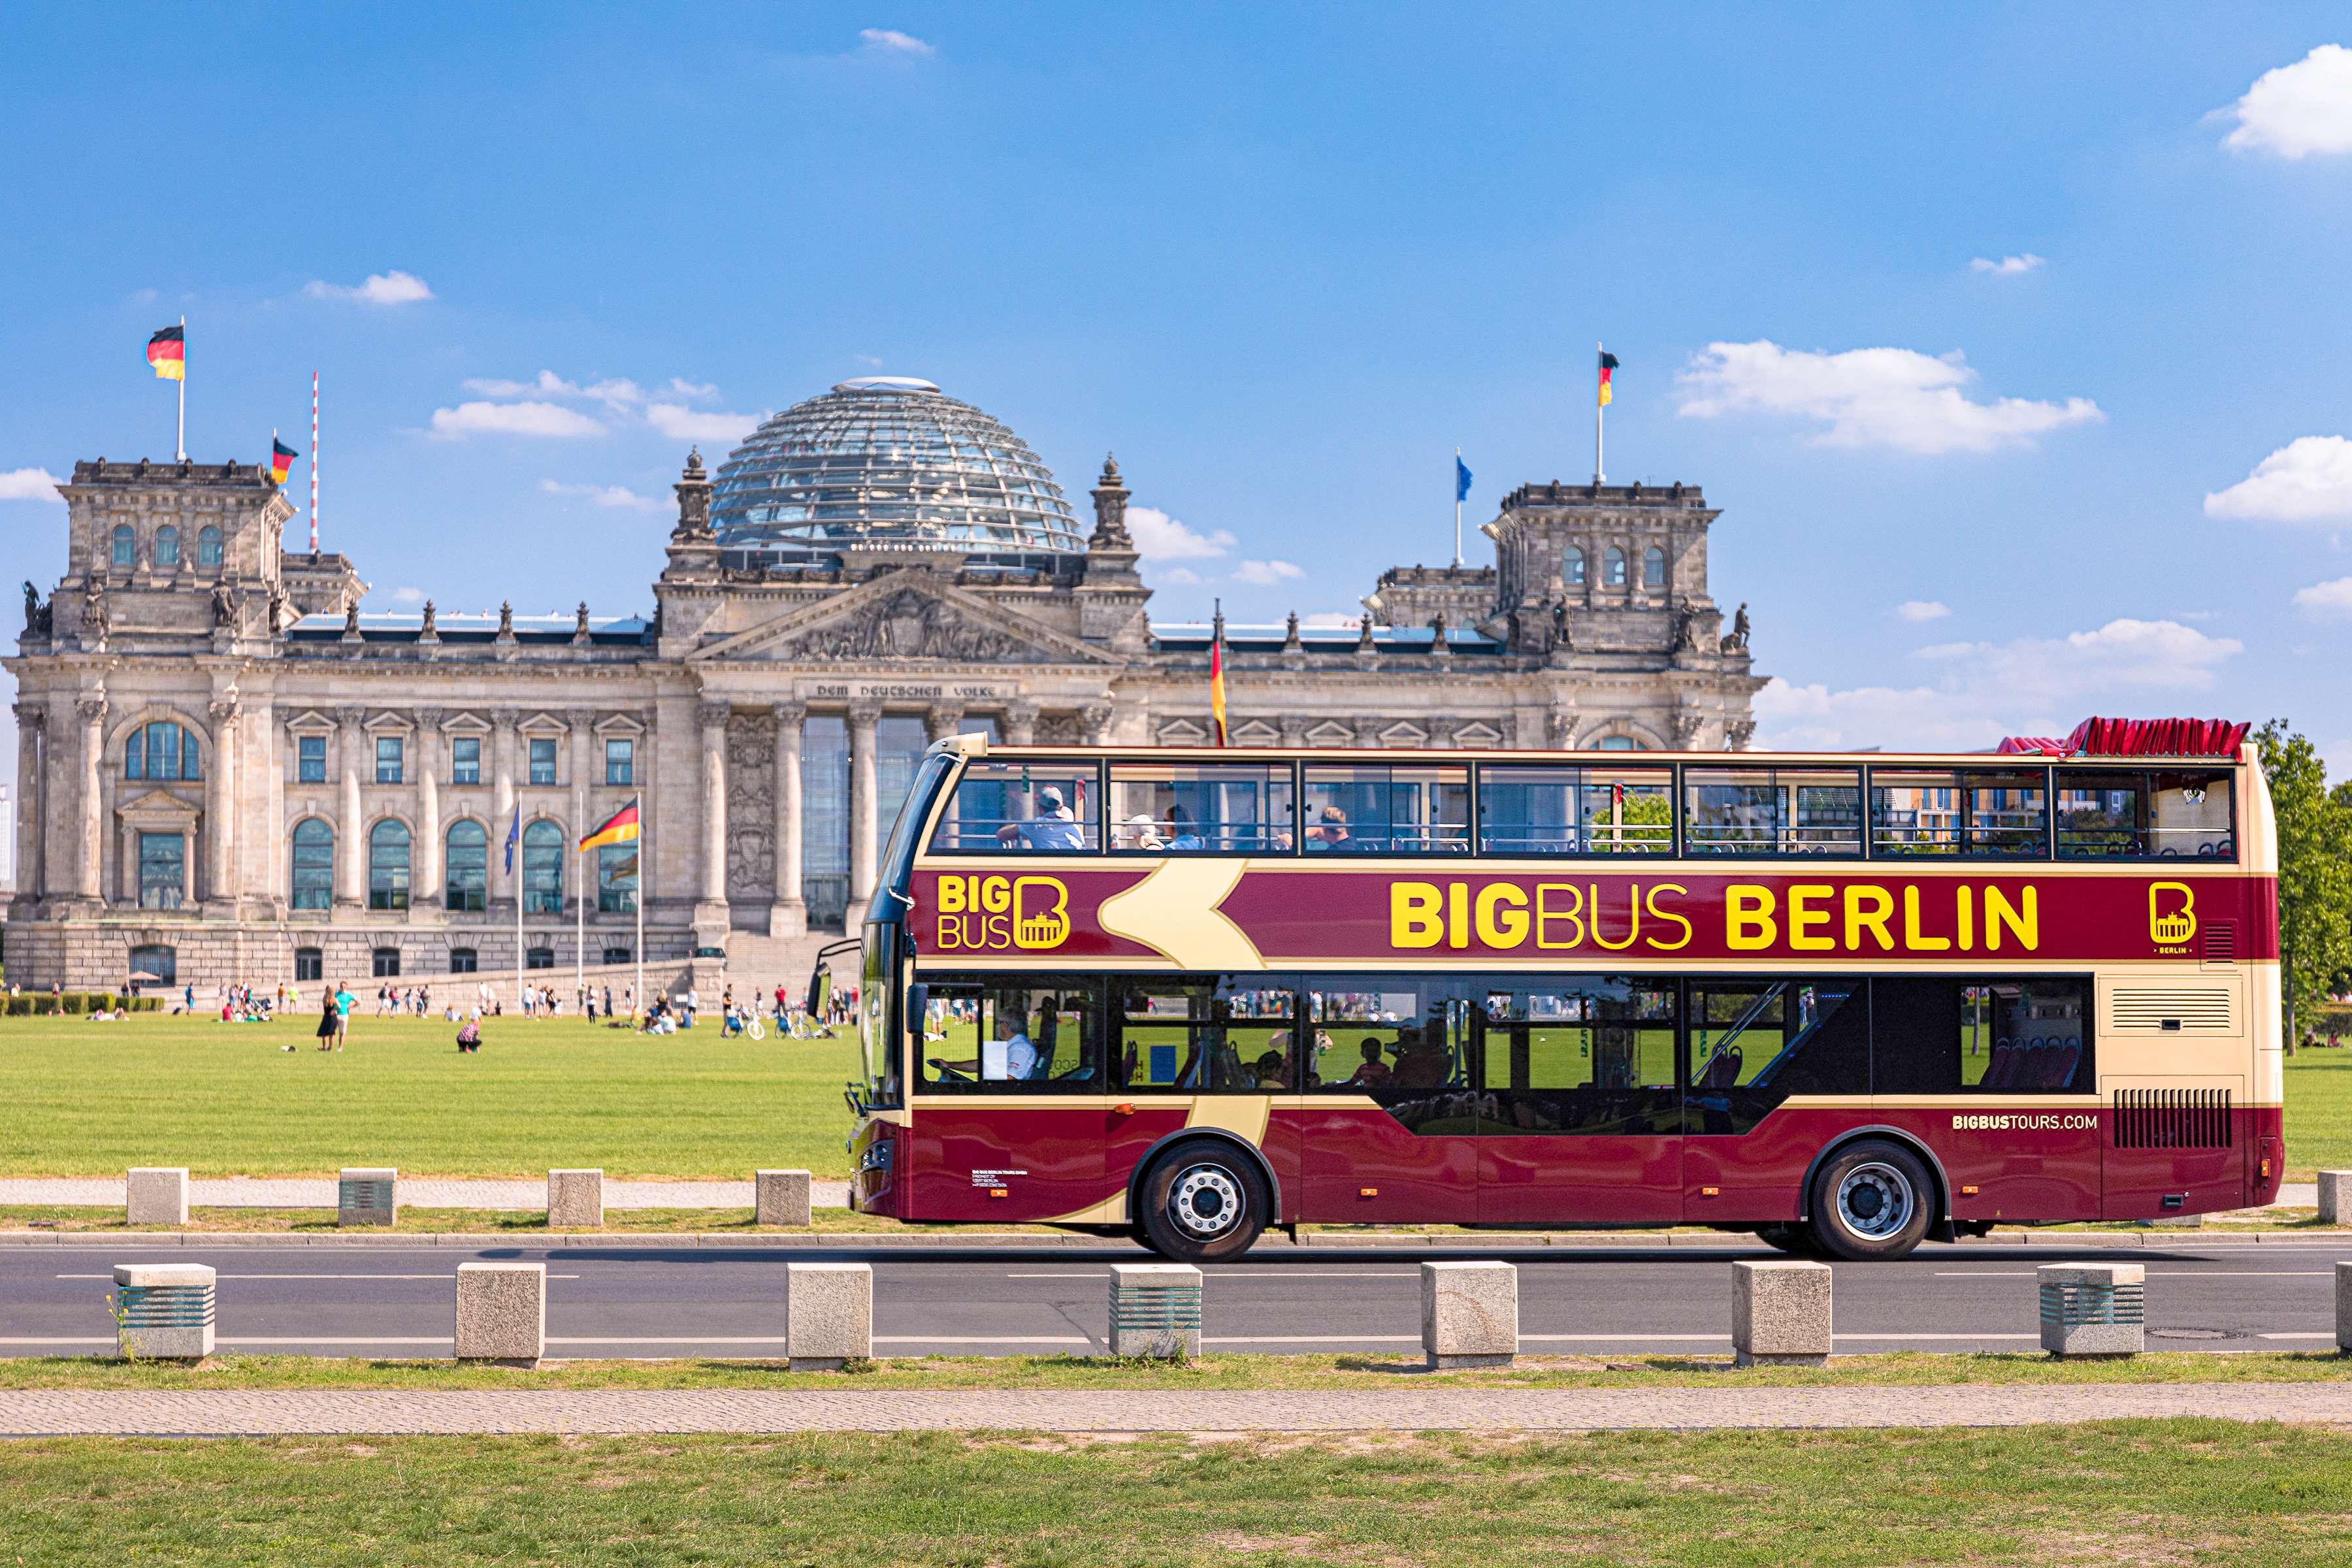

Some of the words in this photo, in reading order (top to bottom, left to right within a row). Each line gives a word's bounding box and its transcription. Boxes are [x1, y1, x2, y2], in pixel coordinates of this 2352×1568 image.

[817, 685, 848, 696] DEM
[860, 685, 942, 696] DEUTSCHEN
[954, 686, 996, 697] VOLKE
[938, 875, 1011, 913] BIG
[938, 915, 1011, 949] BUS
[1725, 885, 2038, 951] BERLIN
[1952, 1115, 2098, 1130] BIGBUSTOURS.COM
